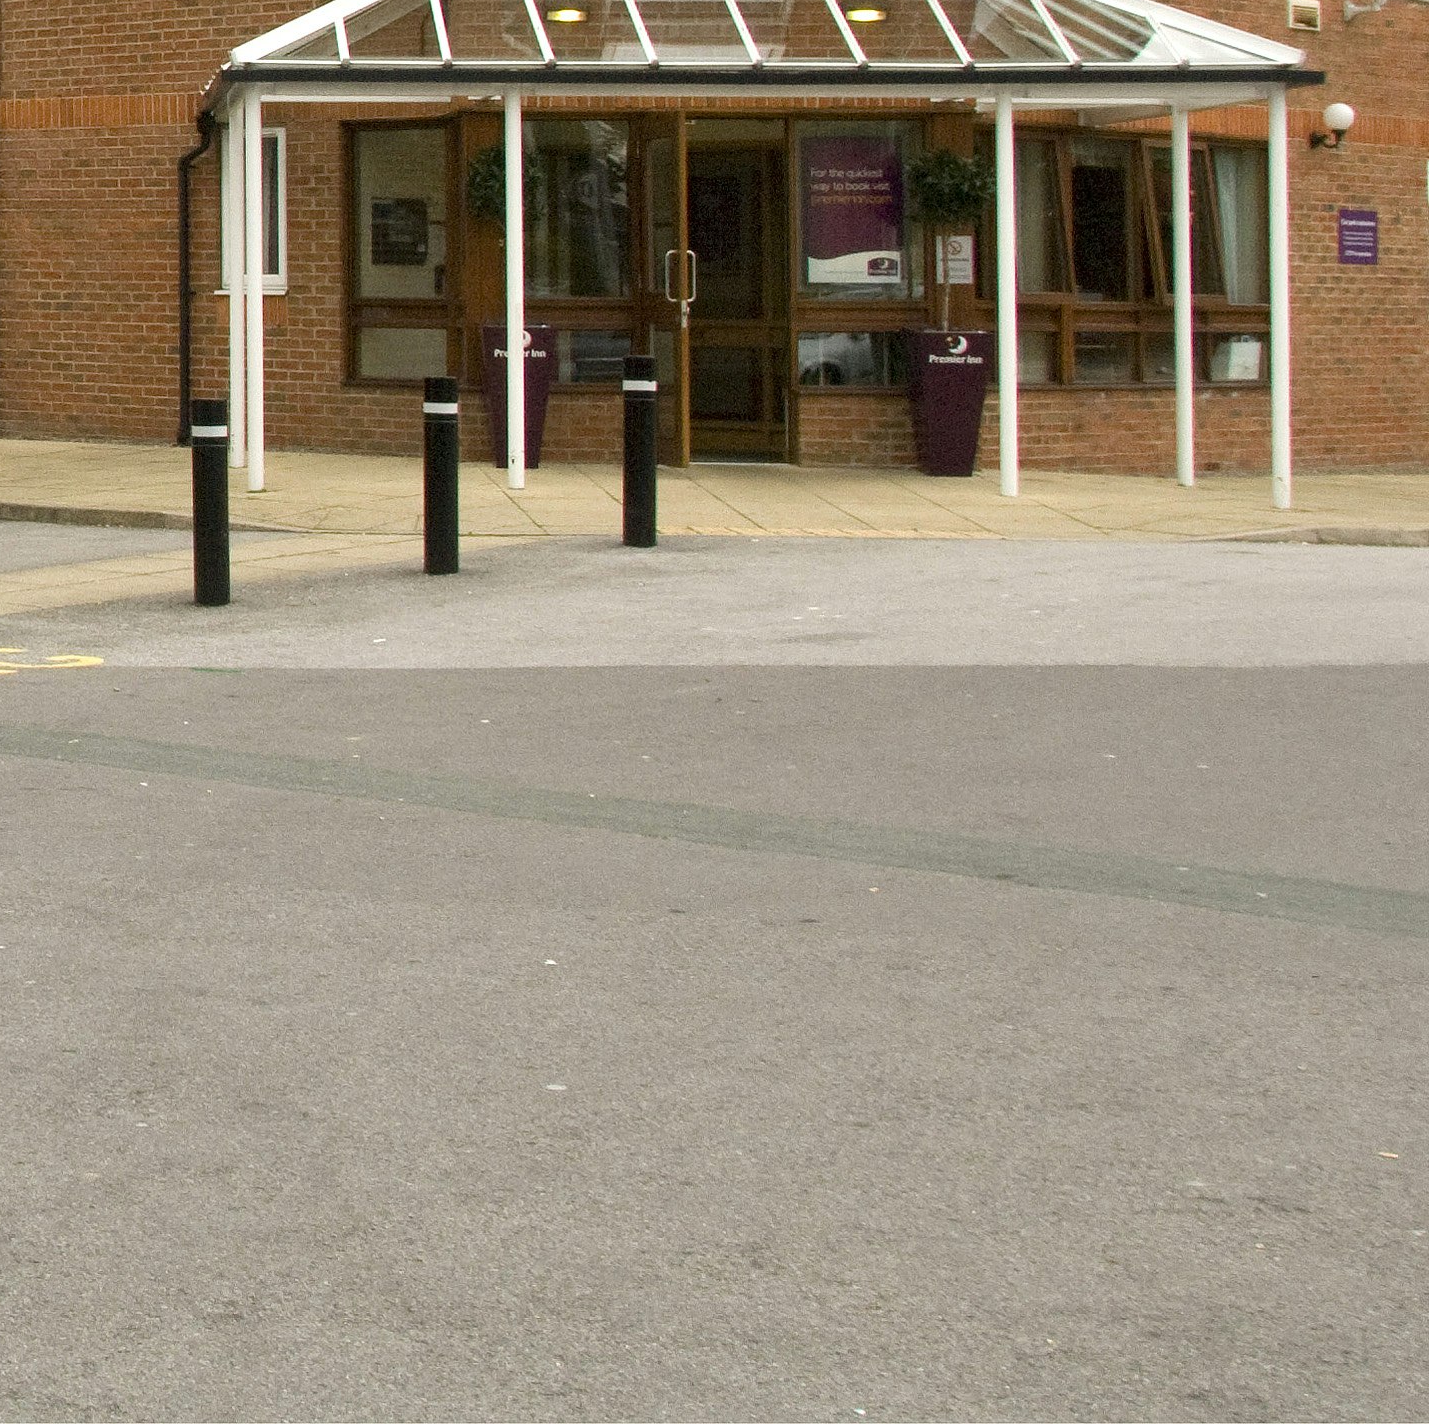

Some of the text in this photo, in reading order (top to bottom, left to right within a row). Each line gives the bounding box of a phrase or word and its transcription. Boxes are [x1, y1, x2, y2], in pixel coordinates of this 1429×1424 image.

[531, 349, 547, 358] Inn
[929, 355, 984, 364] Premier Inn
